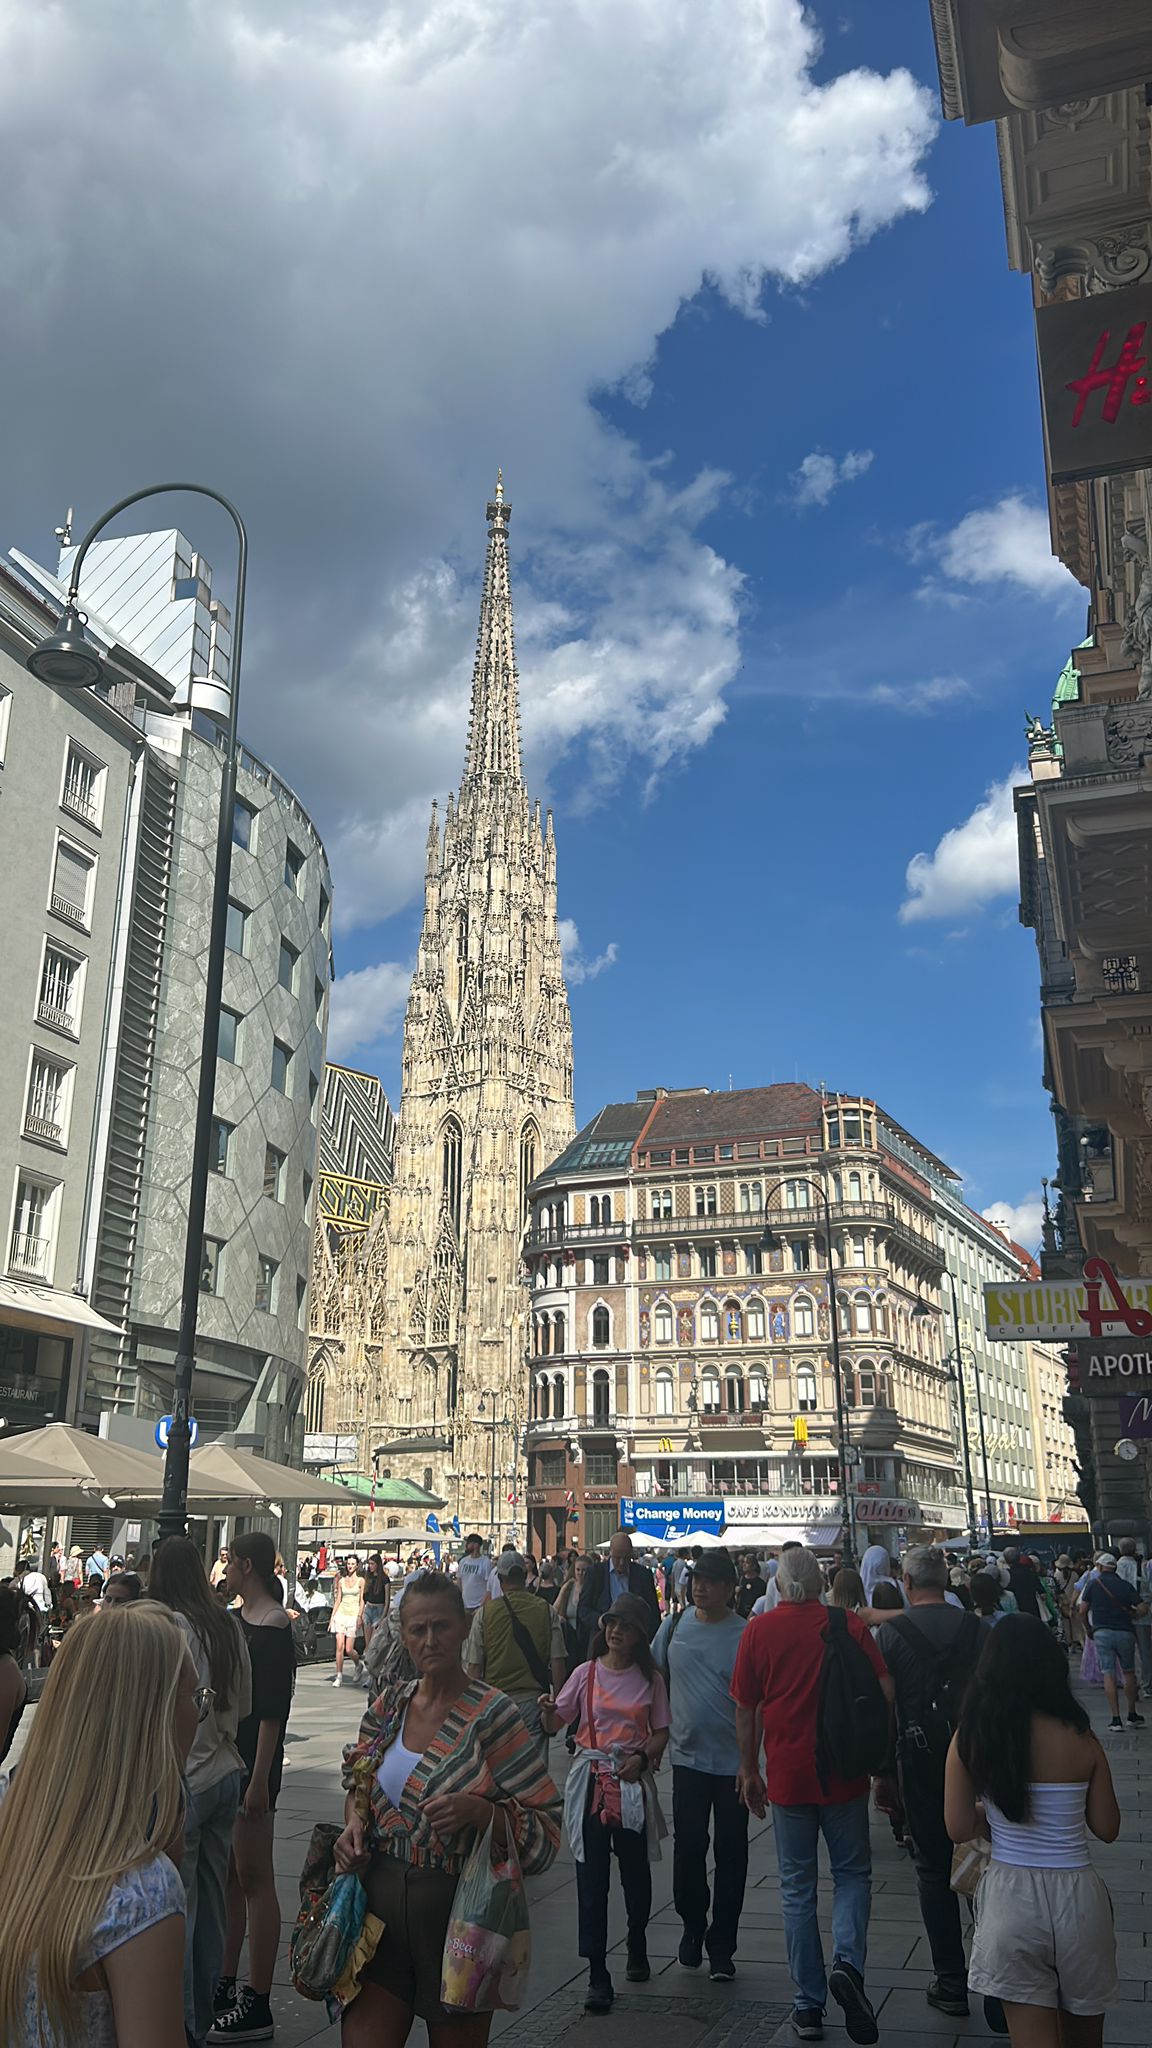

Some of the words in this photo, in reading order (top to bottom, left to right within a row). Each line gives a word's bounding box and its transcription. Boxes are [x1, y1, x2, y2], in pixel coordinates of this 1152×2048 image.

[1000, 1324, 1113, 1334] COIFFU
[967, 1427, 1018, 1458] Ryal
[636, 1508, 680, 1521] Change
[683, 1508, 722, 1521] Money
[728, 1505, 759, 1518] CAFE
